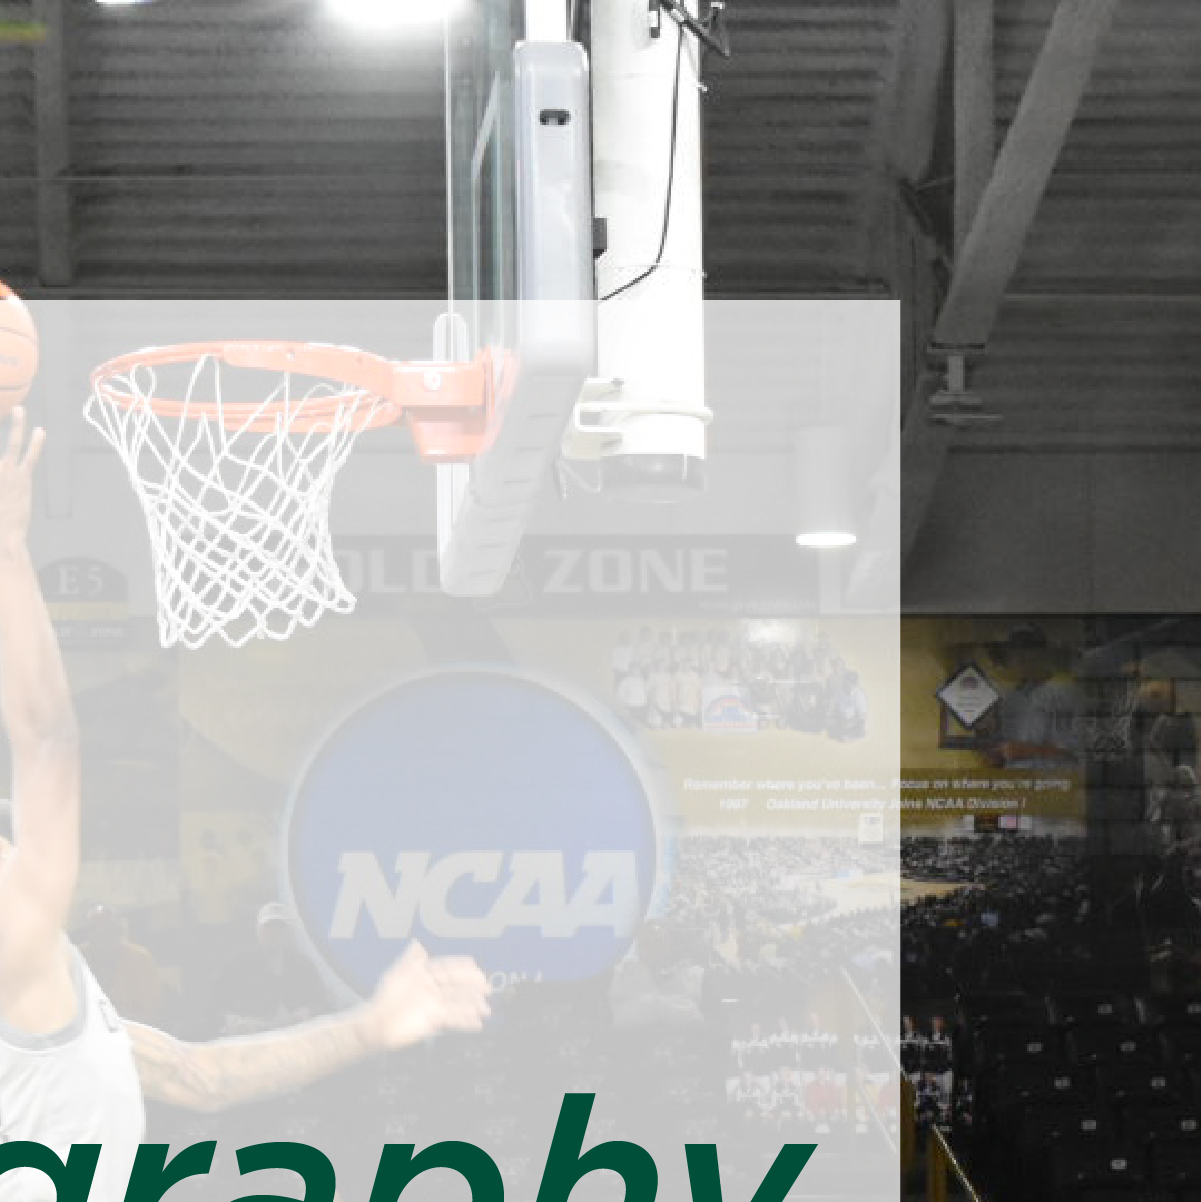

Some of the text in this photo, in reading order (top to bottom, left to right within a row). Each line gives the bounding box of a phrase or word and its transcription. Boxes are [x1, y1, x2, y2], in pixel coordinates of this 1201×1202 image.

[543, 548, 728, 593] ZONE
[684, 777, 753, 790] Remember
[767, 798, 819, 811] Oakland
[821, 798, 885, 814] University
[926, 798, 964, 810] NCAA
[966, 797, 1019, 810] Division
[327, 851, 639, 938] NCAA
